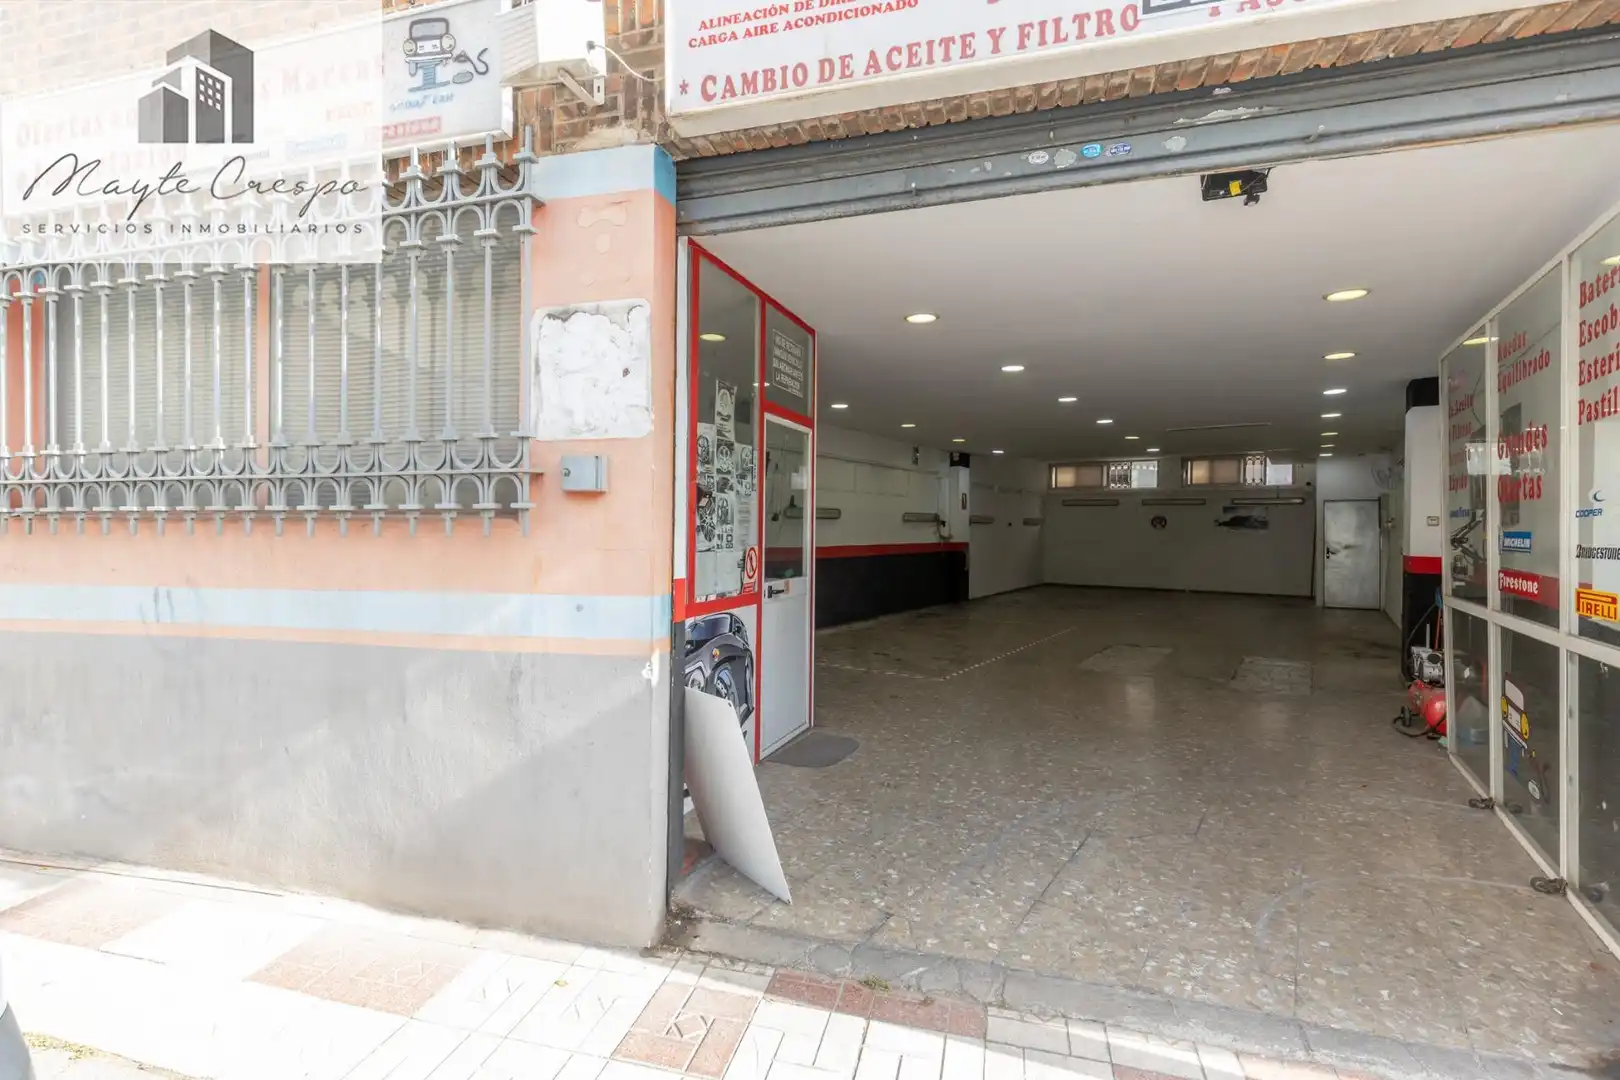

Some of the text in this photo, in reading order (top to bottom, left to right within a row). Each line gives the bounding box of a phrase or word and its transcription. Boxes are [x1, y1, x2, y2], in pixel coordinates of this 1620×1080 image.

[688, 0, 919, 48] CARGA AIRE ACONDICIONADO
[698, 4, 789, 31] ALINEACIÓN
[794, 0, 814, 12] DE
[701, 62, 808, 102] CAMBIO
[817, 54, 854, 83] DE
[864, 32, 976, 76] ACEITE
[987, 27, 1006, 54] Y
[1578, 386, 1618, 426] Pastil
[1498, 421, 1547, 460] Grandes
[1575, 508, 1603, 518] COOPER
[1499, 572, 1539, 595] Firestone
[1576, 591, 1617, 621] PIRELLI
